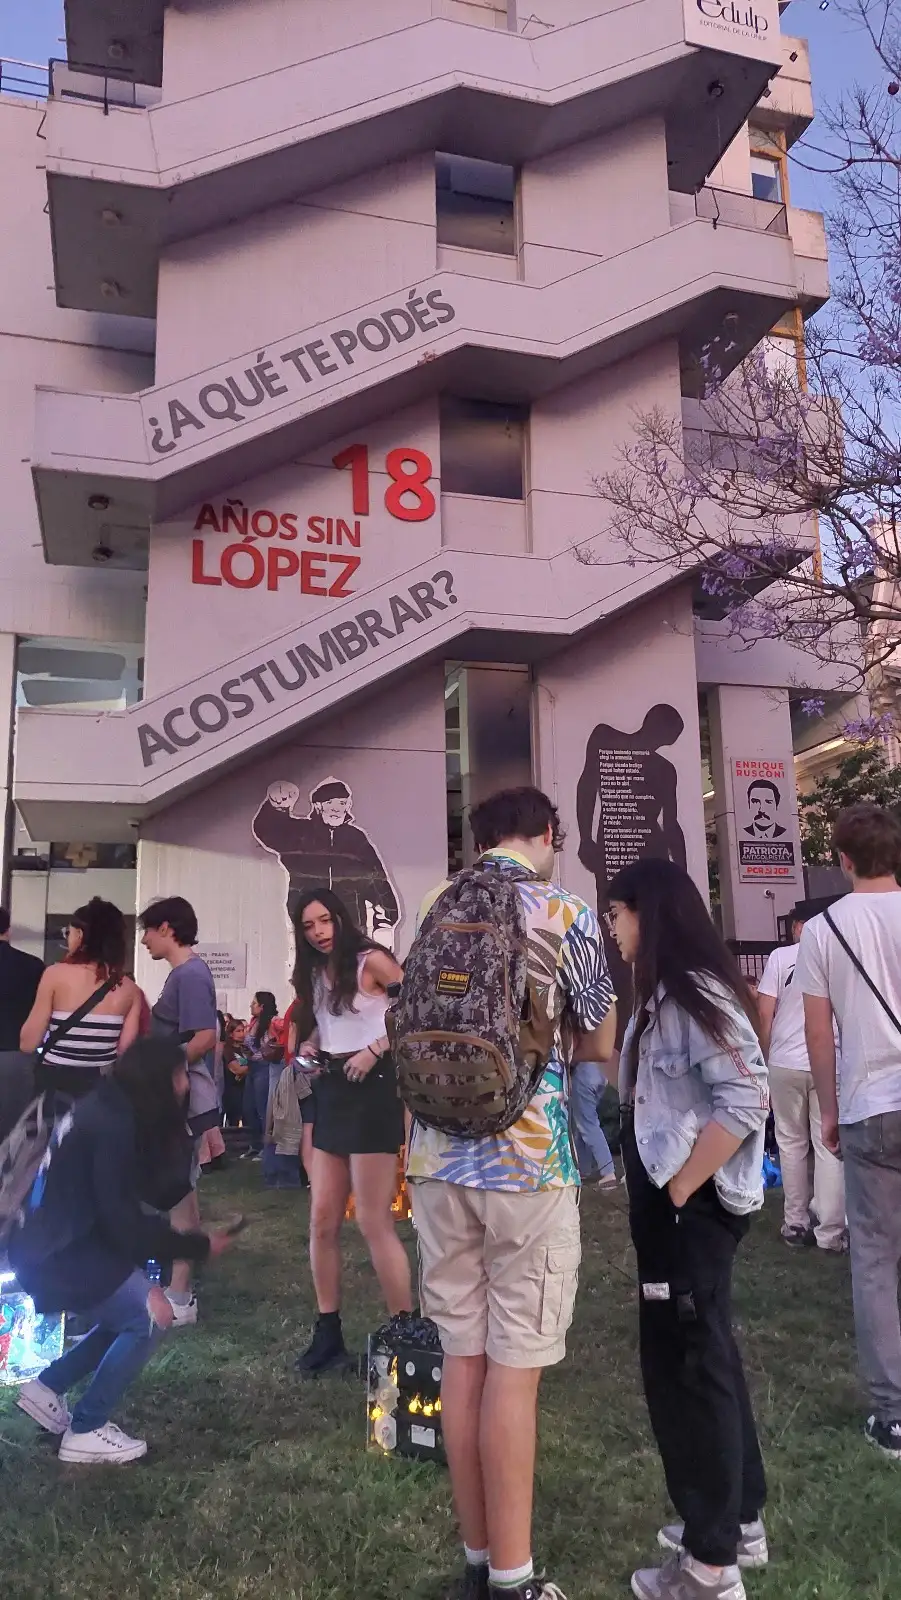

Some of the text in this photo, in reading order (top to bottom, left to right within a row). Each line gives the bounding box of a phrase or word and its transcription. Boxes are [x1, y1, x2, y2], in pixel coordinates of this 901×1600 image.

[148, 288, 456, 454] ¿A QUÉ TE PODÉS
[331, 444, 436, 522] 18
[193, 498, 362, 547] AÑOS SIN
[192, 535, 362, 598] LÓPEZ
[136, 569, 458, 768] ACOSTUMBRAR?
[735, 761, 784, 770] ENRIQUE
[736, 770, 785, 778] RUSCONI
[743, 846, 793, 857] PATRIOTA,
